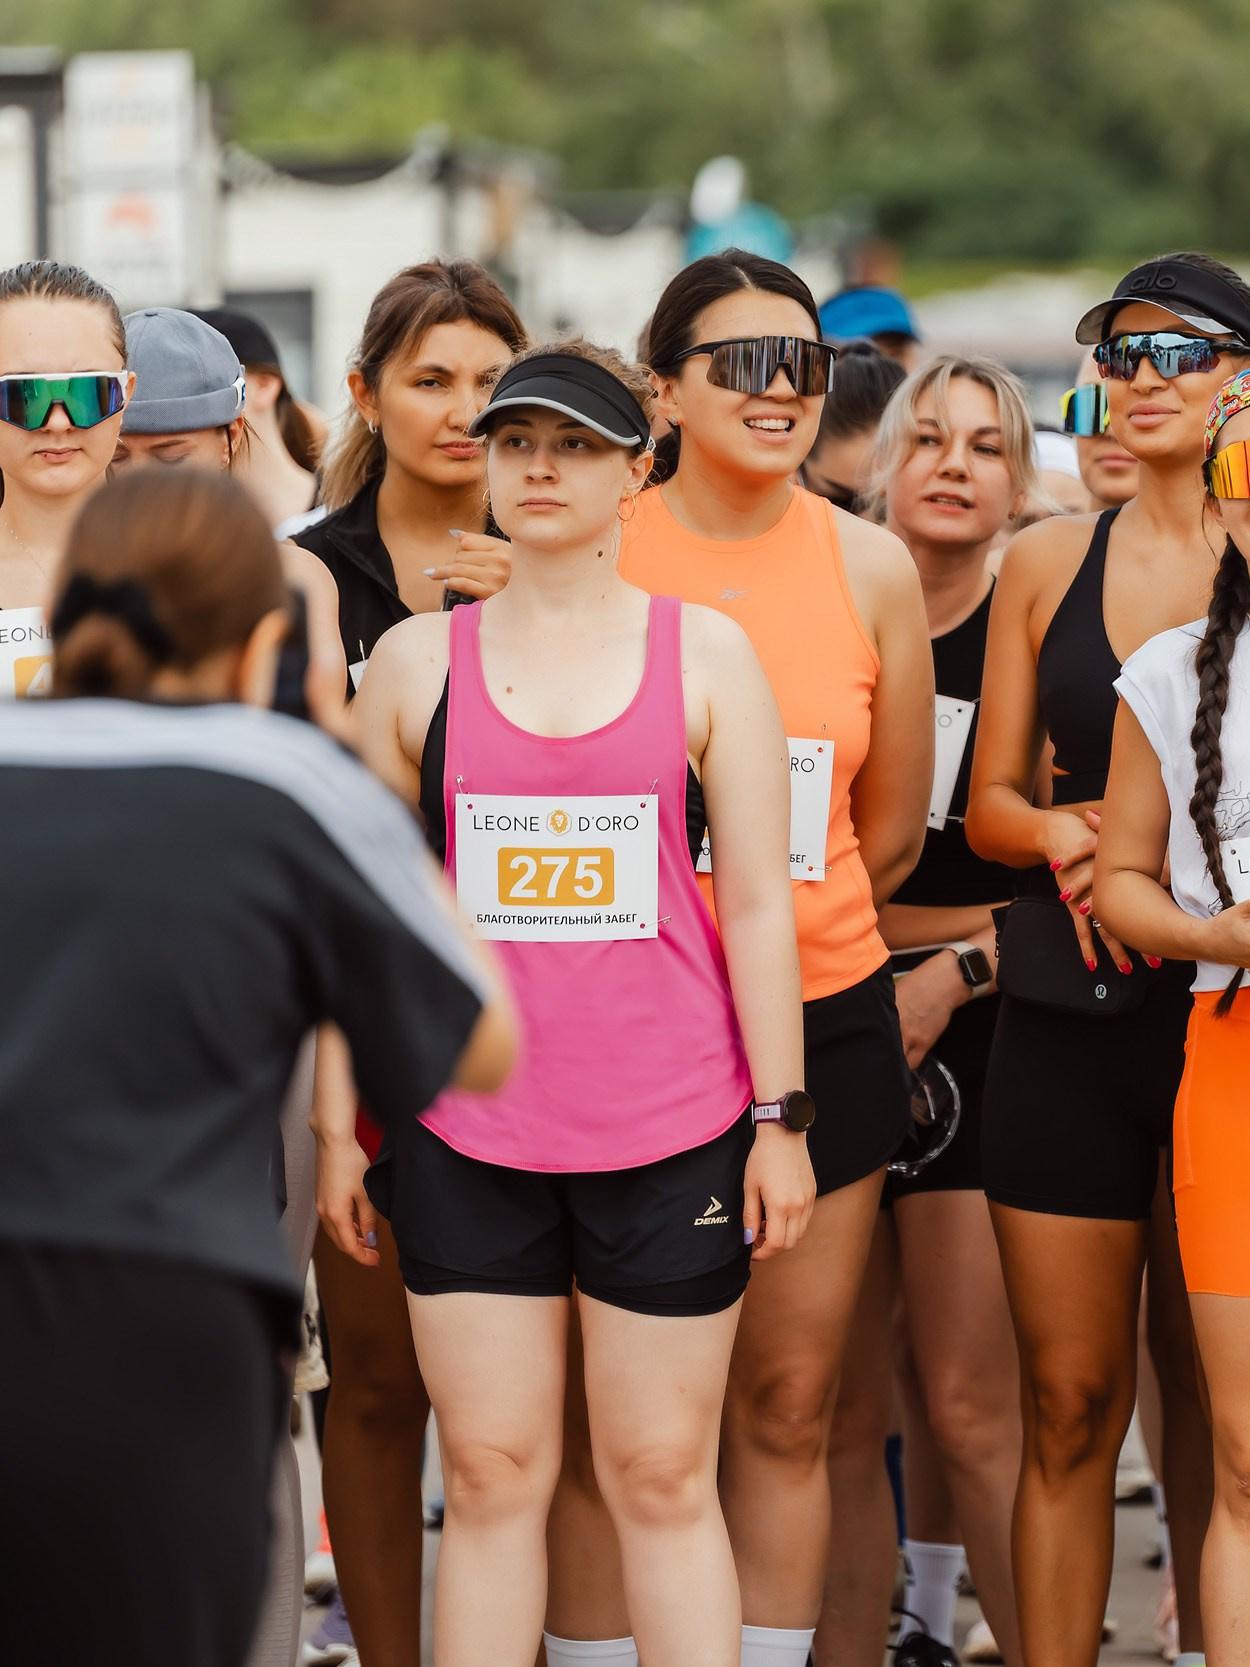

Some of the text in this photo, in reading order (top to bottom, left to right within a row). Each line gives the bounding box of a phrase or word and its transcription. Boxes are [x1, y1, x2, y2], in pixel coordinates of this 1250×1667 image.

[473, 815, 639, 832] LEONE D'ORO
[509, 855, 603, 899] 275
[476, 912, 638, 925] БЛАГОТВОРИТЕЛЬНЫЙ ЗАБЕГ
[694, 1215, 729, 1226] DEMIX
